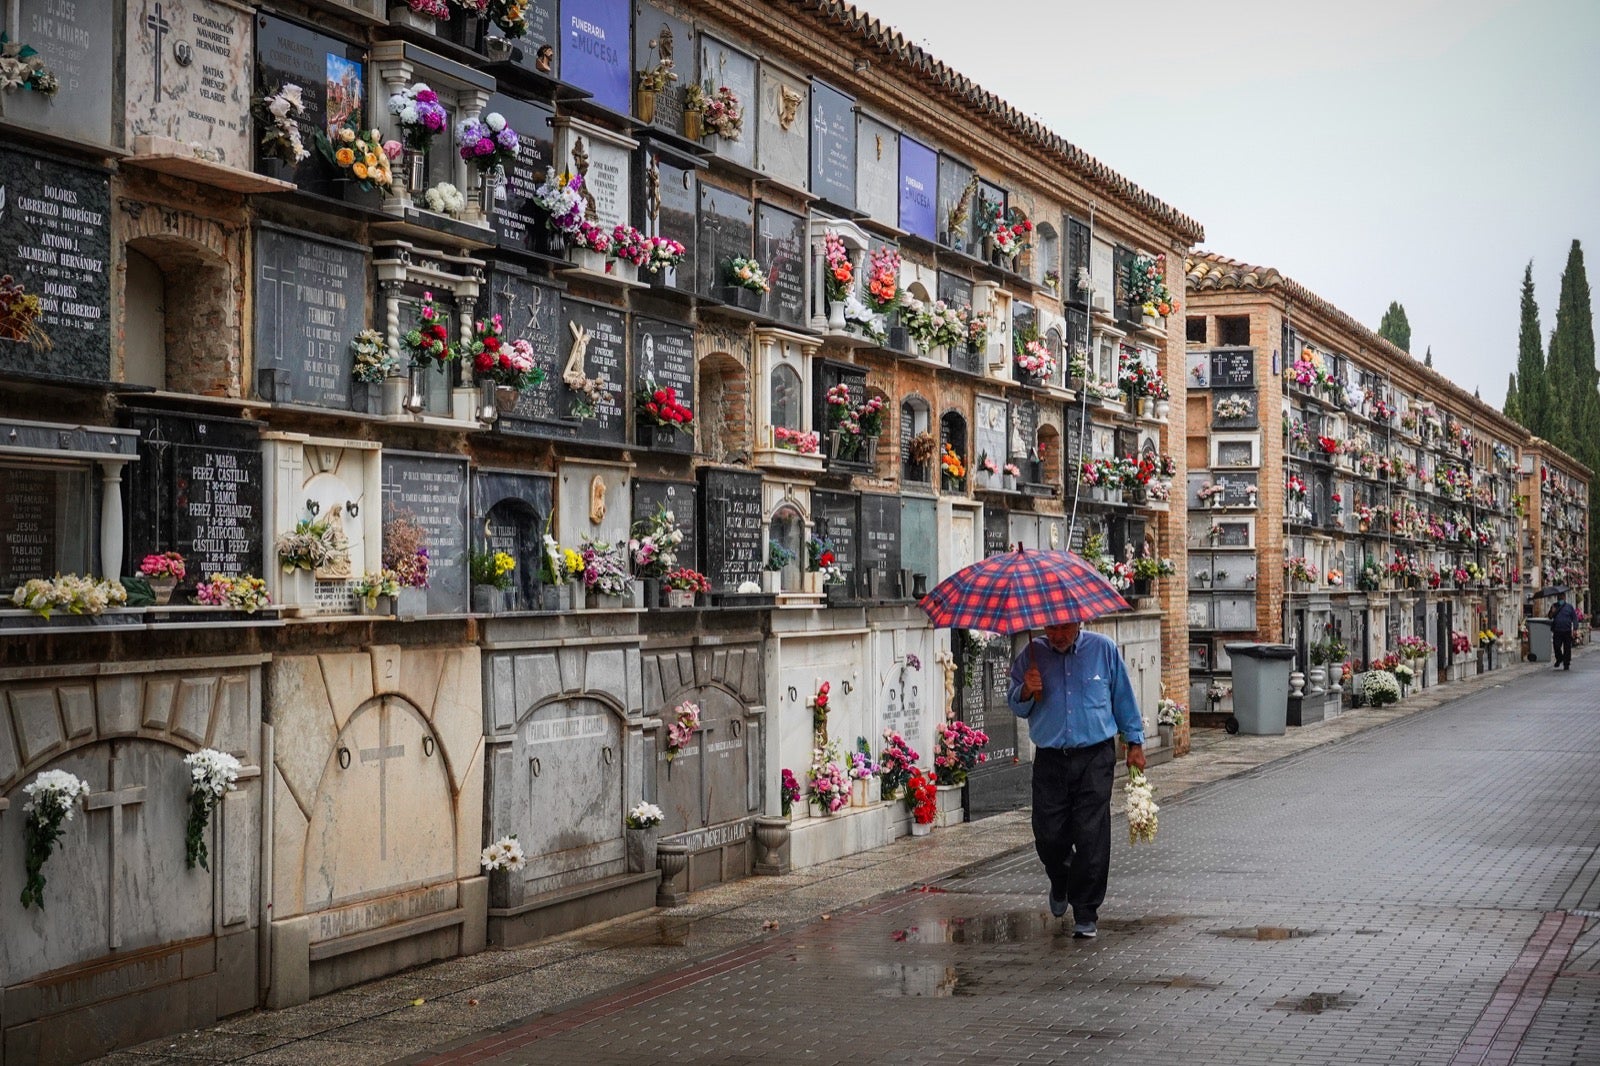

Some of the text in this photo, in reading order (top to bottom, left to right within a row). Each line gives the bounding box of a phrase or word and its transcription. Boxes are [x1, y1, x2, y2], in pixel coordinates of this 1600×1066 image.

[32, 14, 89, 50] SANZ NAVARRO
[192, 13, 234, 36] ENCARNACIÓN
[571, 16, 606, 41] FUNERARIA
[197, 27, 231, 46] NAVARRETE
[195, 38, 232, 58] HERNÁNDEZ
[571, 32, 620, 67] EMUCESA
[199, 87, 227, 104] VELARDE
[187, 110, 238, 132] DESCANSEN EN PAZ
[522, 145, 544, 161] ORTEGA
[513, 166, 534, 181] MATILDE
[905, 175, 924, 191] FUNERARIA
[44, 185, 78, 204] DOLORES
[905, 187, 932, 210] EMUCESA
[18, 196, 103, 227] CABRERIZO RODRÍGUEZ
[40, 232, 73, 251] ANTONIO
[17, 244, 103, 273] SALMERÓN HERNÁNDEZ
[44, 282, 78, 299] DOLORES
[62, 301, 101, 319] CABRERIZO
[215, 455, 238, 470] MARIA
[192, 467, 250, 483] PEREZ CASTILLA
[5, 494, 49, 505] SANTAMARIA
[214, 491, 237, 505] RAMON
[189, 503, 253, 519] PEREZ FERNANDEZ
[16, 521, 39, 532] JESUS
[207, 527, 245, 540] PATROCINIO
[6, 533, 48, 545] MEDIAVILLA
[192, 539, 250, 553] CASTILLA PEREZ
[11, 545, 43, 556] TABLADO
[200, 562, 243, 573] VUESTRA FAMILIA
[384, 658, 393, 679] 2
[319, 909, 361, 939] FAMILIA
